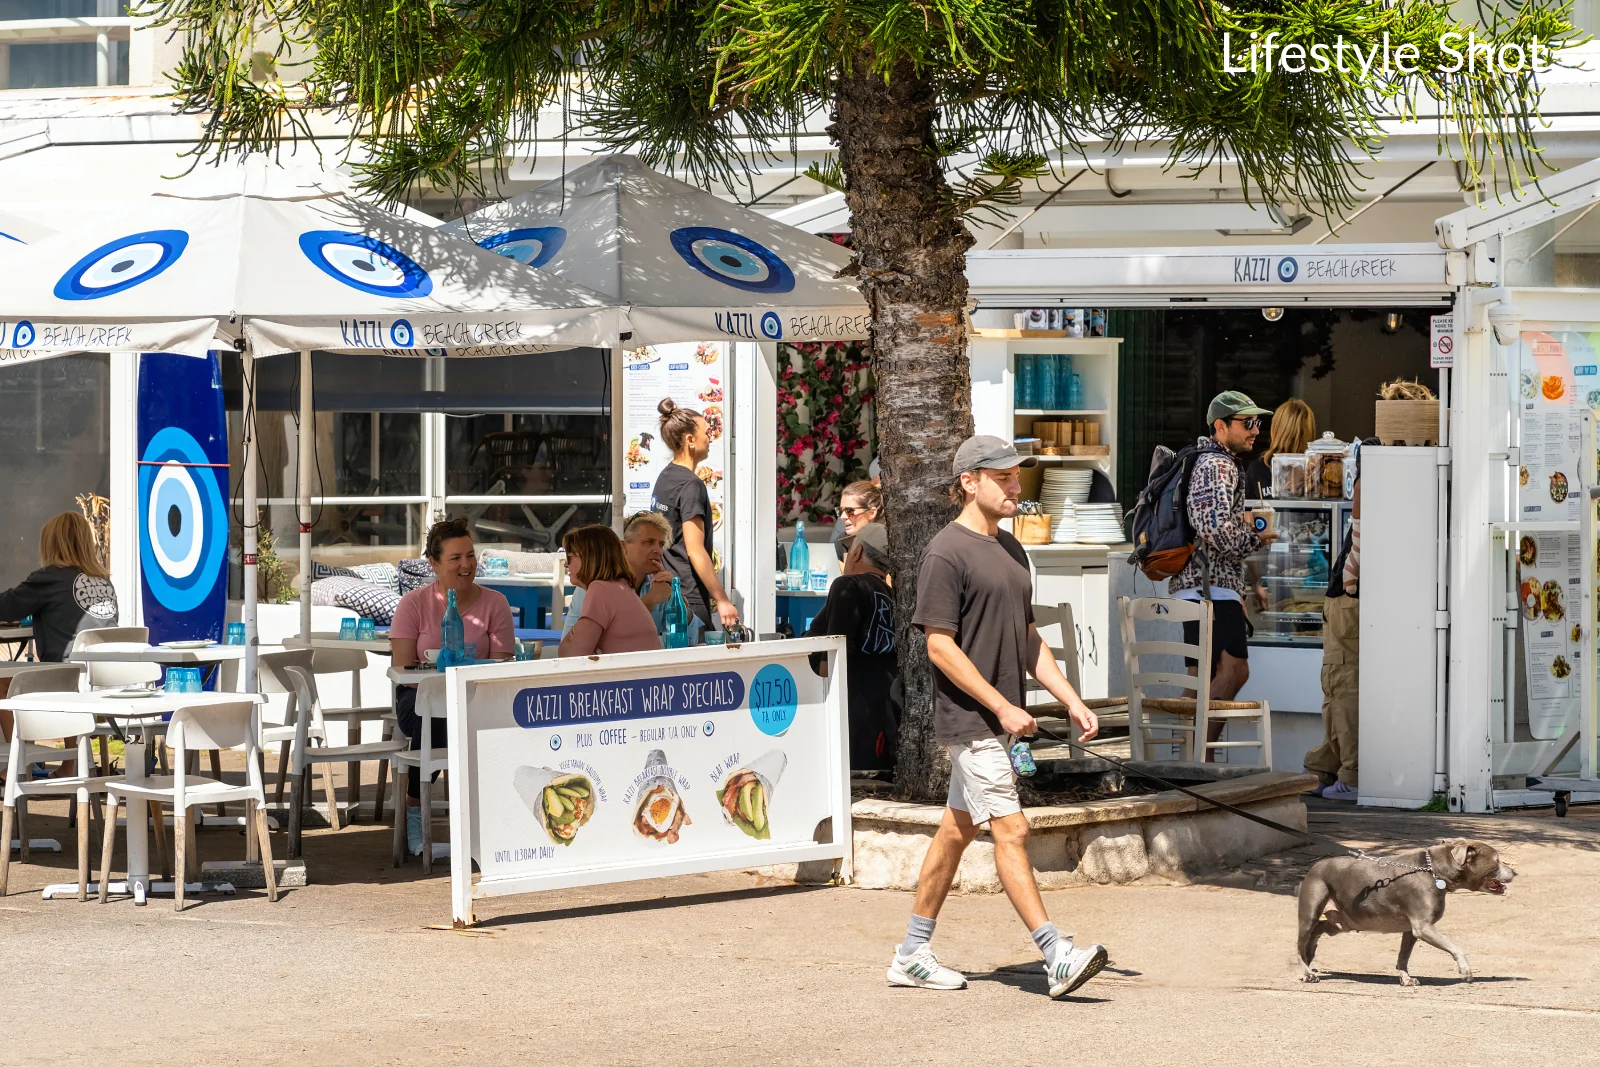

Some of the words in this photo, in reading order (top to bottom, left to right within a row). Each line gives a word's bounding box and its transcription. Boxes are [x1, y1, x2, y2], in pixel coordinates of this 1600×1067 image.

[1234, 257, 1270, 282] KAZZI
[1306, 259, 1349, 278] BEACH
[1350, 258, 1396, 278] GREEK
[42, 325, 87, 347] BEACH
[87, 326, 133, 347] GREEK
[339, 318, 387, 348] KAZZI
[422, 321, 470, 345] BEACH
[473, 320, 526, 344] GREEK
[714, 311, 757, 339] KAZZI
[790, 315, 833, 337] BEACH
[835, 315, 872, 336] GREE
[76, 586, 117, 601] CURL
[526, 694, 562, 722] KAZZI
[569, 688, 634, 718] BREAKFAST
[641, 684, 674, 712] WRAP
[682, 679, 734, 710] SPECIALS
[754, 678, 792, 712] $17.50
[762, 711, 770, 724] TA
[772, 709, 786, 722] ONLY
[576, 734, 592, 748] PLUS
[600, 728, 627, 746] COFFEE
[640, 728, 666, 742] REGULAR
[668, 726, 678, 740] T/A
[681, 725, 698, 738] ONLY
[559, 758, 585, 770] VEGETARIAN
[710, 764, 724, 782] BLAT
[724, 752, 740, 769] WRAP
[622, 784, 636, 804] KAZZI
[634, 765, 658, 786] BREAKFAST
[678, 775, 690, 791] WRAP
[494, 850, 512, 862] UNTIL
[540, 846, 555, 860] DAILY
